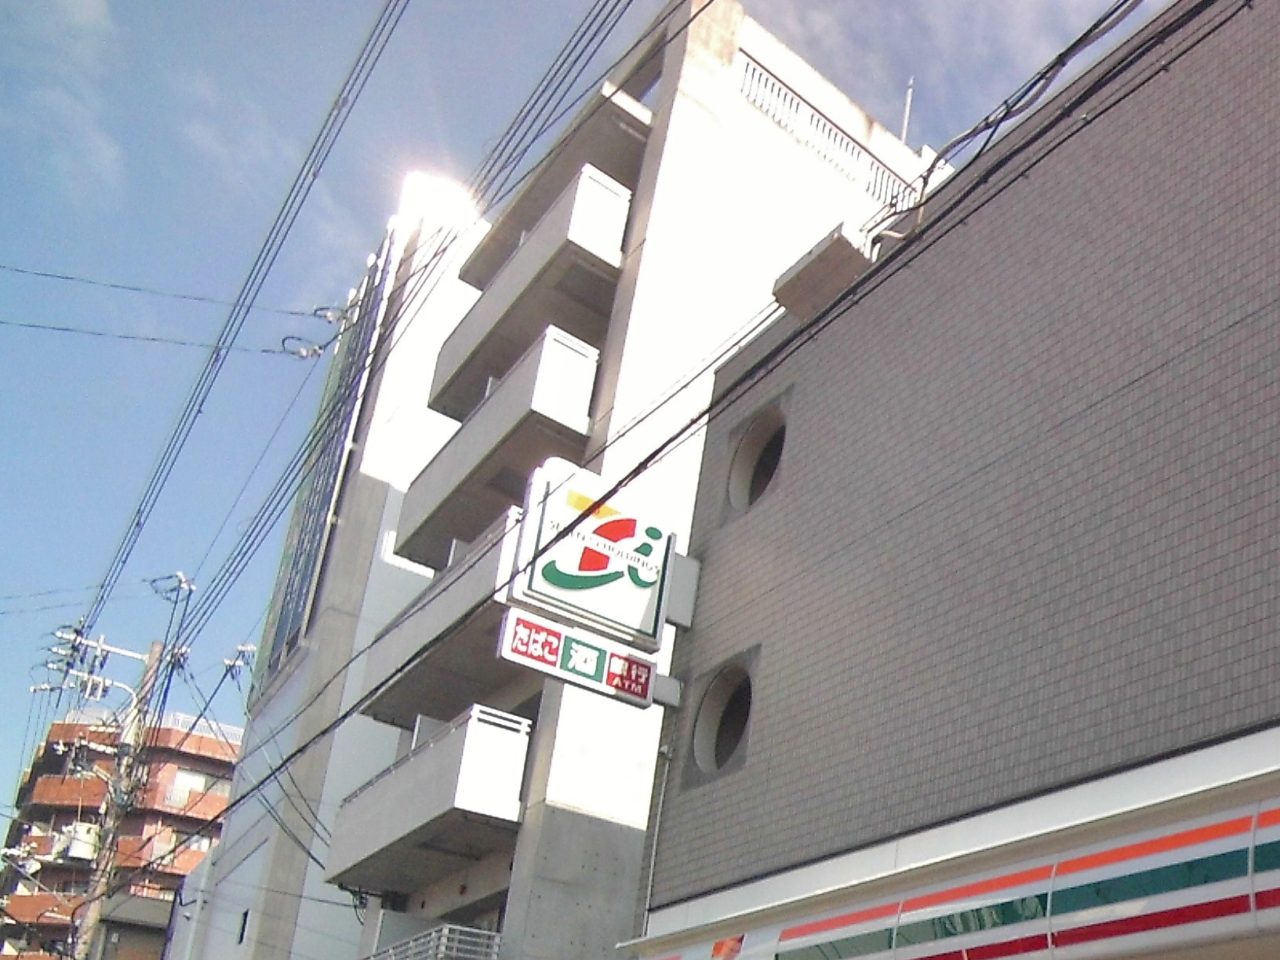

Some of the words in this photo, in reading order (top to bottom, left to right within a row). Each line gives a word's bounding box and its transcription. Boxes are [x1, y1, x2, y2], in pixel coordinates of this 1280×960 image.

[512, 623, 559, 662] たばこ
[567, 641, 599, 676] 酒
[612, 676, 642, 694] ATM
